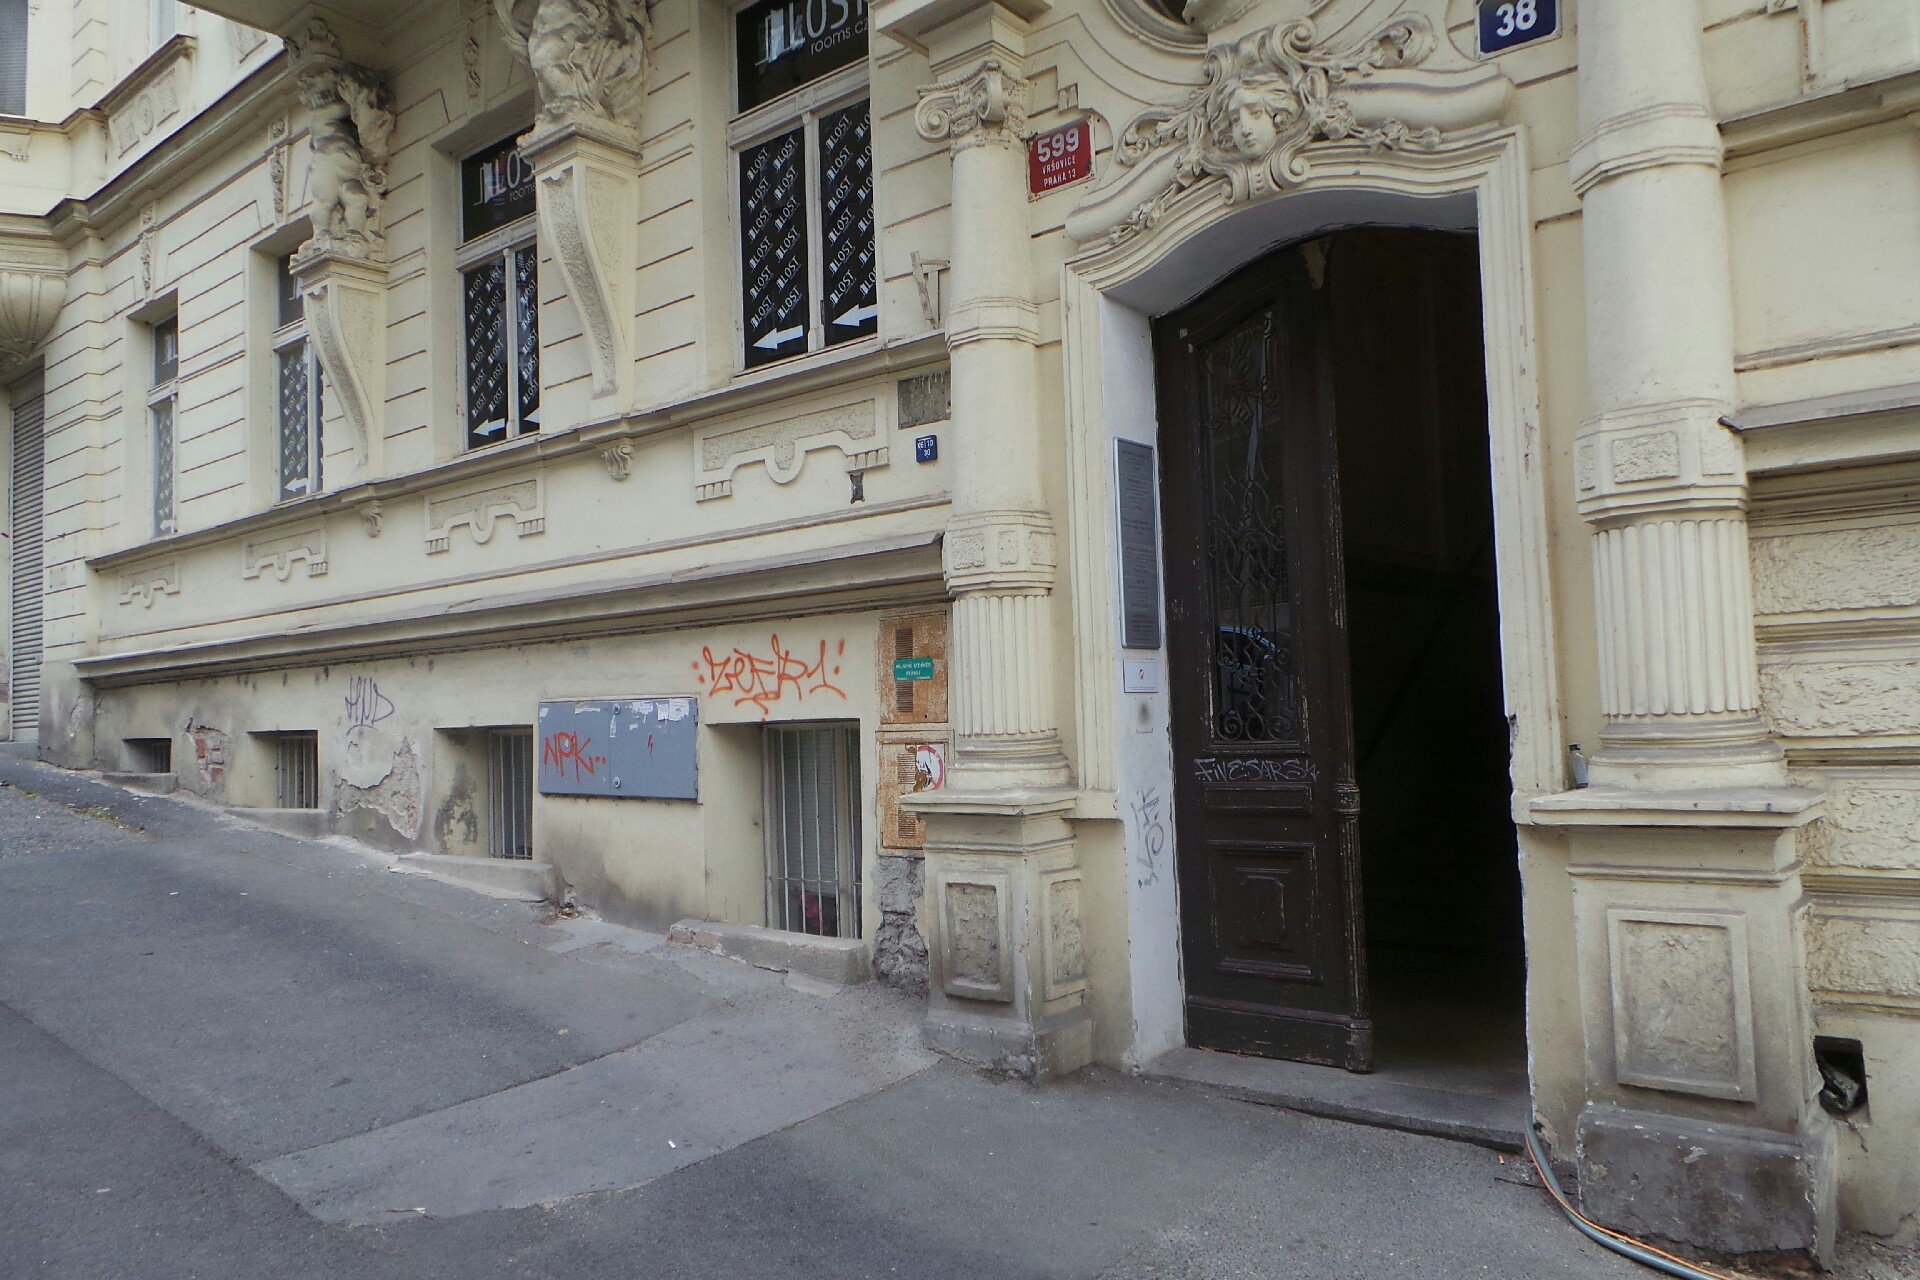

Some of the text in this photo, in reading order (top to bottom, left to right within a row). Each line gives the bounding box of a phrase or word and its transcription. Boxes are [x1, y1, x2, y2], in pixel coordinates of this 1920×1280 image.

[1496, 0, 1537, 37] 38
[830, 114, 850, 143] LOST
[777, 135, 796, 164] LOST
[1037, 127, 1079, 162] 599
[750, 147, 769, 174] LOST
[831, 145, 851, 174] LOST
[1042, 155, 1076, 175] VRŠOVICE
[750, 176, 769, 203] LOST
[778, 164, 797, 194] LOST
[832, 175, 852, 205] LOST
[1043, 168, 1076, 187] PRAHA 13
[752, 205, 771, 234] LOST
[779, 195, 798, 223] LOST
[833, 207, 853, 235] LOST
[753, 236, 771, 263] LOST
[780, 225, 799, 254] LOST
[833, 238, 854, 267] LOST
[753, 265, 772, 292] LOST
[780, 255, 800, 284] LOST
[834, 269, 855, 299] LOST
[754, 294, 773, 323] LOST
[781, 284, 801, 314] LOST
